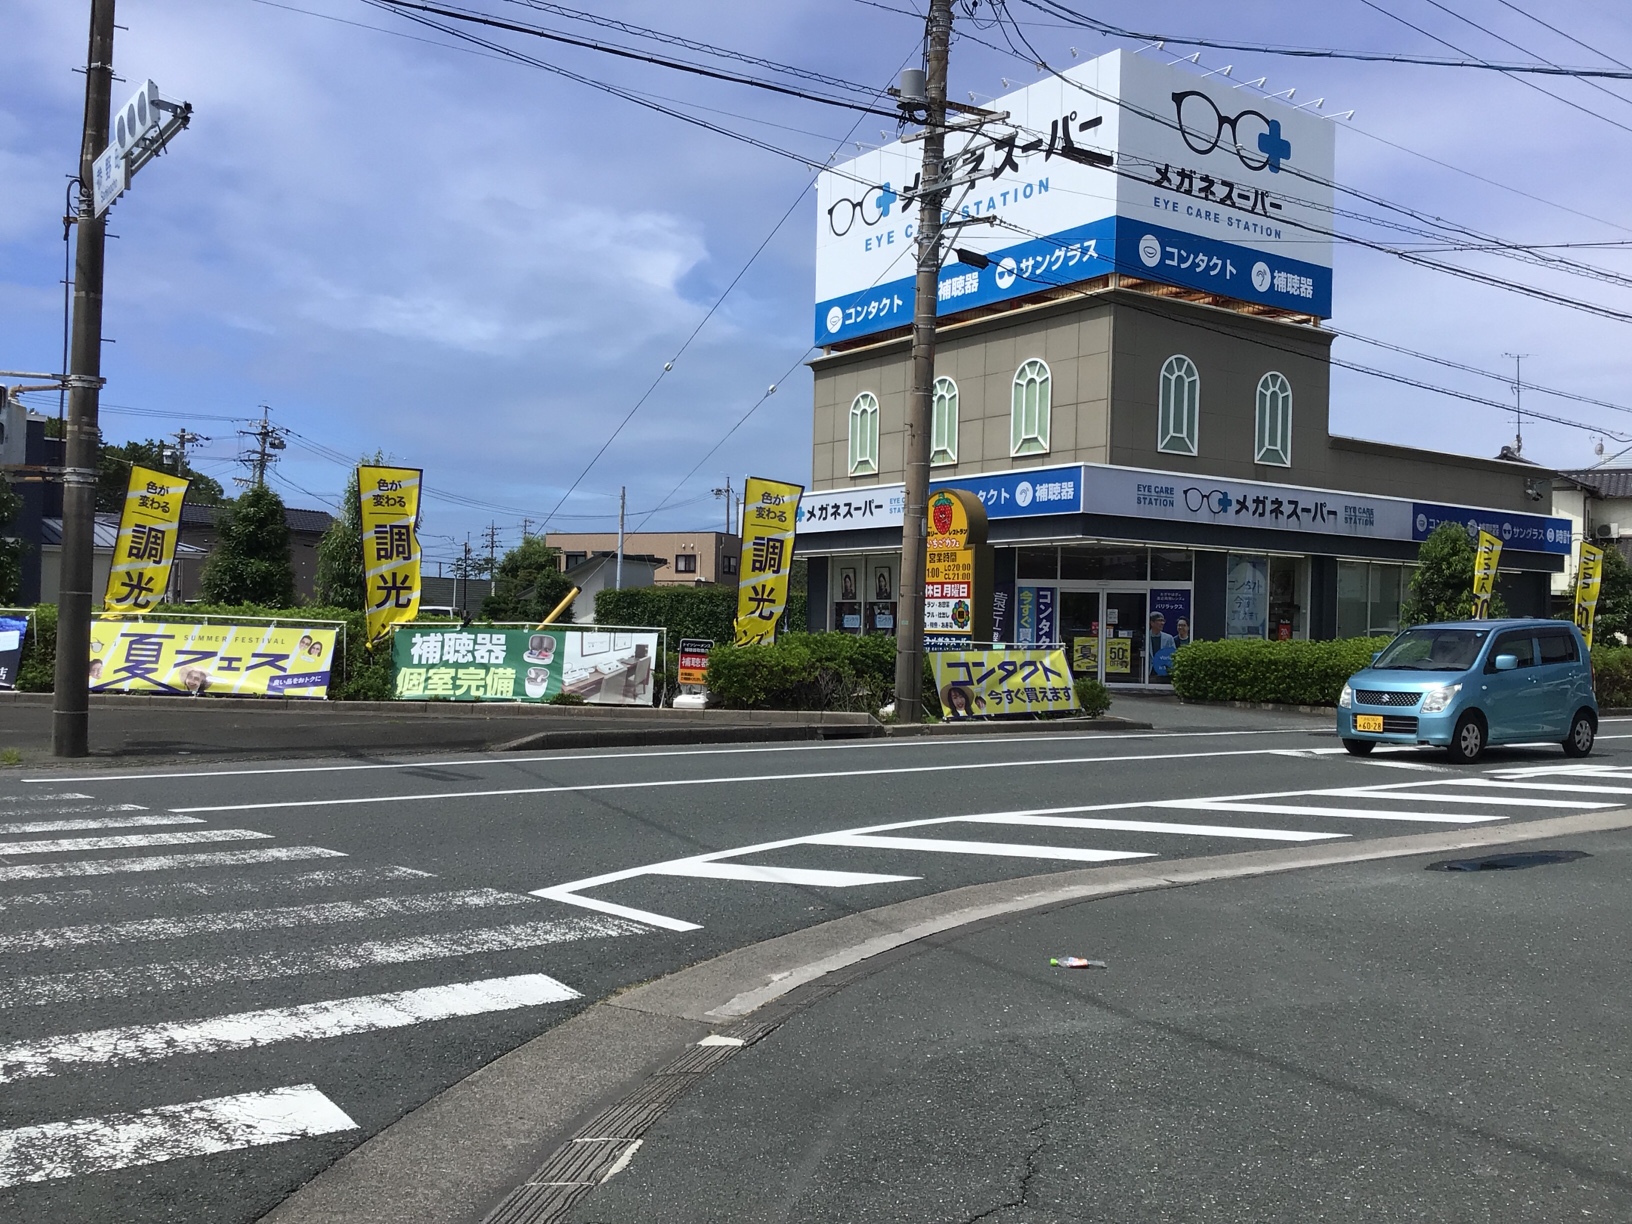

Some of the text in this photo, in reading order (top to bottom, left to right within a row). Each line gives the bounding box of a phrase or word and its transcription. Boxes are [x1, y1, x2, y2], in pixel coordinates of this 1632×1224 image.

[1154, 163, 1282, 216] メガネスーパー
[864, 231, 895, 252] EYE
[962, 177, 1050, 219] STATION
[1154, 196, 1282, 240] EYE CARE STATION
[1165, 246, 1313, 298] コンタクト 補聴器
[845, 239, 1098, 325] コンタクト 補聴器 サングラス
[146, 480, 169, 497] 色が
[377, 478, 402, 492] 色が
[1035, 481, 1074, 502] 補聴器
[1137, 484, 1174, 495] EYE CARE
[138, 495, 171, 513] 変わる
[372, 494, 406, 508] 変わる
[761, 491, 785, 505] 色が
[1137, 496, 1174, 507] STATION
[755, 506, 787, 523] 変わる
[806, 500, 883, 522] メガネスーパー
[1235, 494, 1338, 524] メガネスーパー
[1345, 505, 1374, 516] EYE CARE
[1345, 516, 1374, 527] STATION
[1513, 526, 1545, 541] サングラス
[1555, 532, 1571, 545] 時計
[116, 523, 166, 610] 調光
[374, 524, 412, 609] 調光
[929, 552, 957, 563] 営業時間
[748, 536, 785, 621] 調光
[943, 584, 968, 597] 月曜日
[184, 634, 286, 645] SUMMER FESTIVAL
[410, 631, 507, 665] 補聴器
[95, 633, 290, 692] 夏フェス
[272, 675, 322, 687] 良い品をおトクに
[396, 666, 516, 697] 個室完備
[946, 660, 1062, 686] コンタクト
[988, 686, 1072, 706] 今すぐ買えます
[1363, 722, 1382, 731] 60-28
